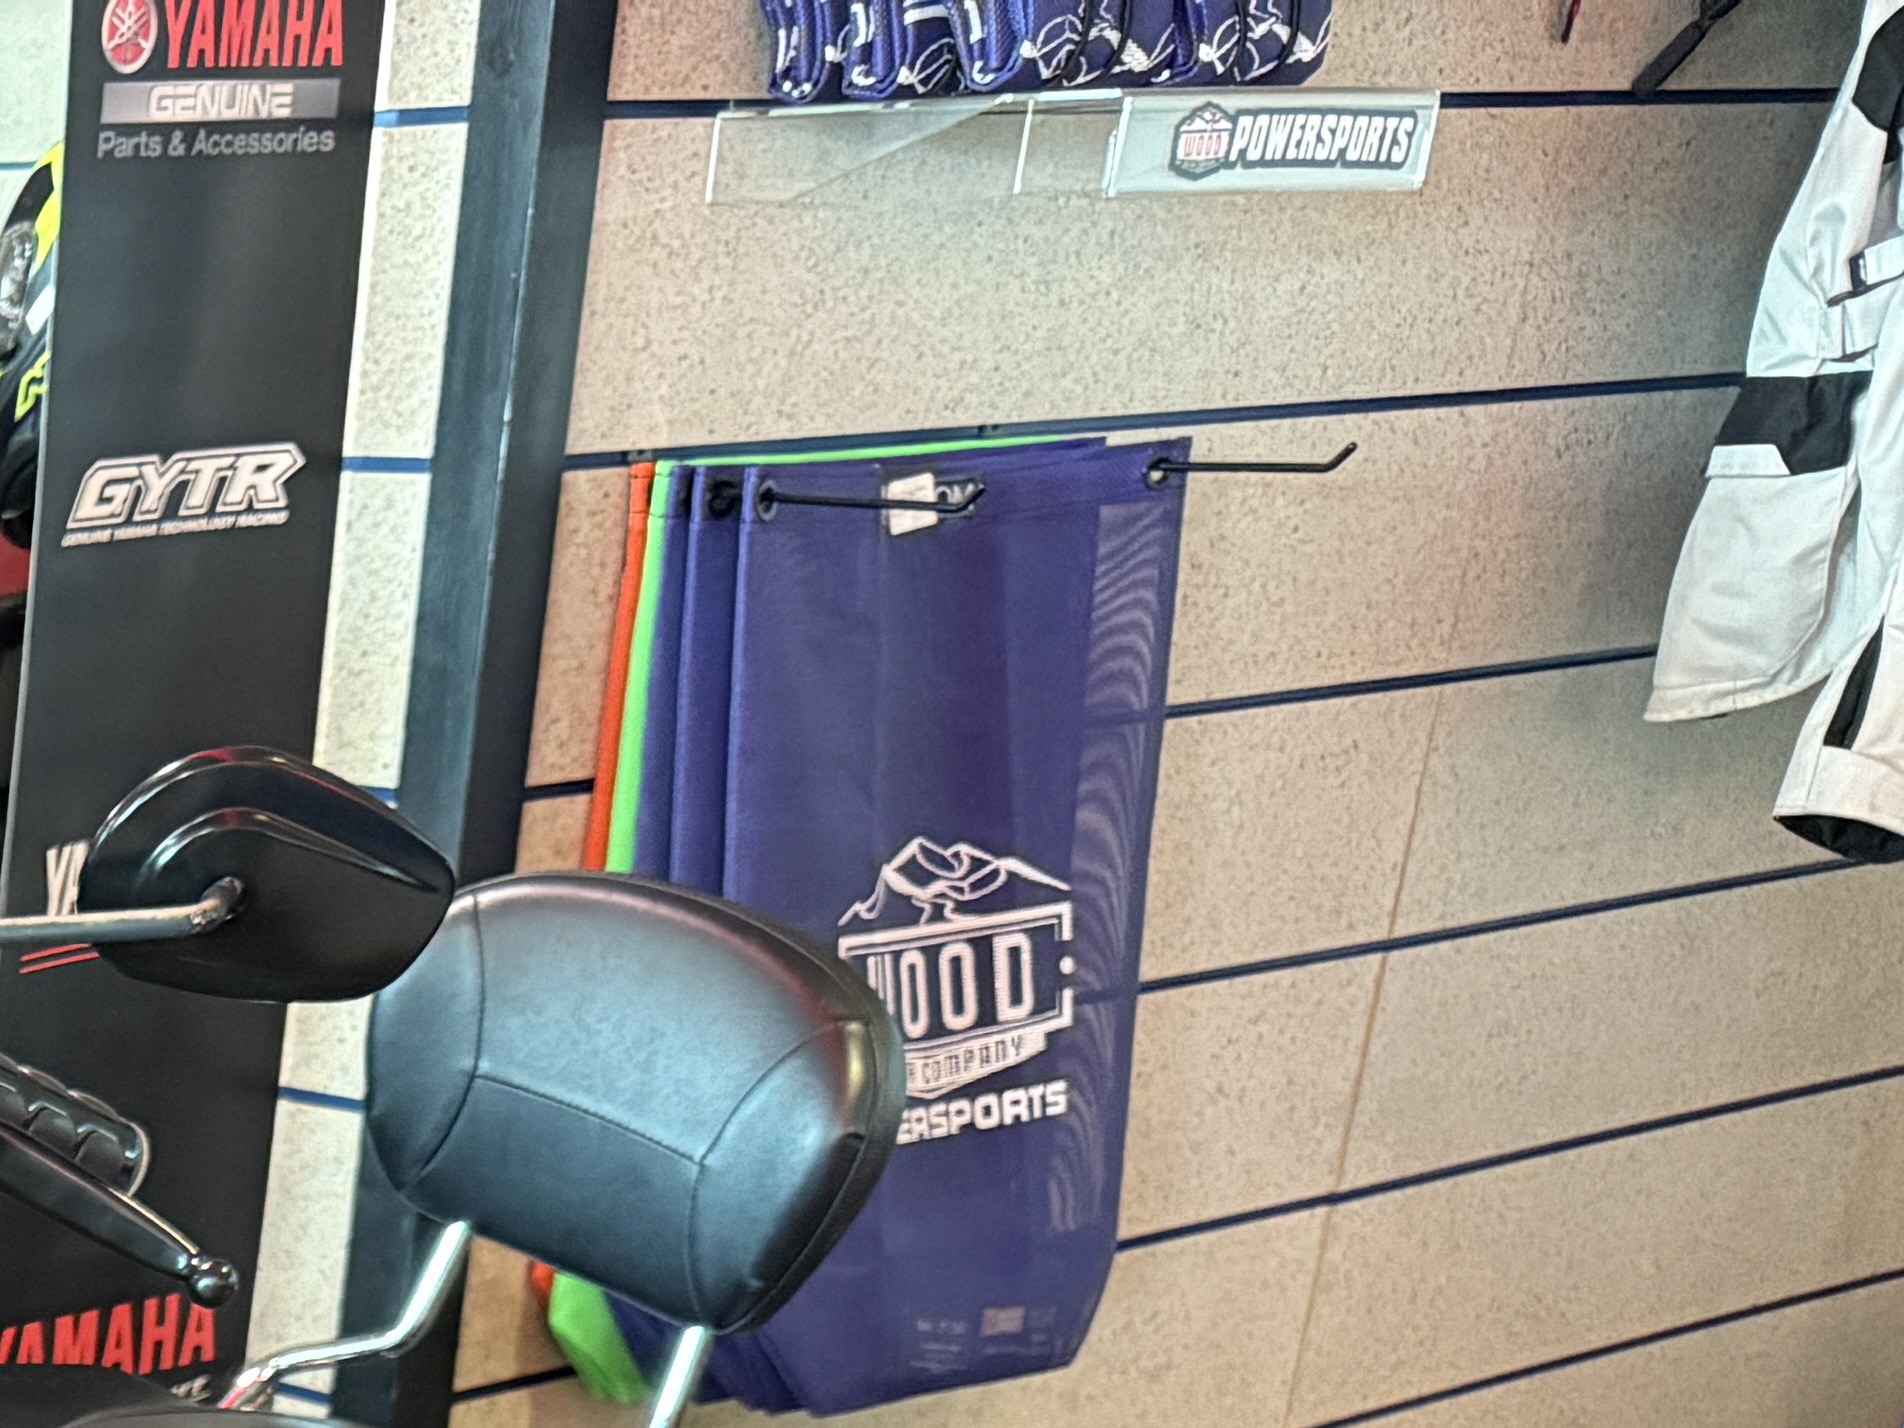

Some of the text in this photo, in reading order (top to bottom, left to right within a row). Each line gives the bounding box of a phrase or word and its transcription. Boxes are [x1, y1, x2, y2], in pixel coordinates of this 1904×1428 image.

[165, 0, 343, 68] YAMAHA
[148, 83, 293, 118] GENUINE
[97, 126, 336, 158] Parts & Accessories
[1184, 113, 1415, 163] WOOD POWERSPORTS
[70, 446, 301, 526] GYTR
[922, 1033, 1024, 1085] COMPANY
[896, 1079, 1069, 1145] ERSPORTS
